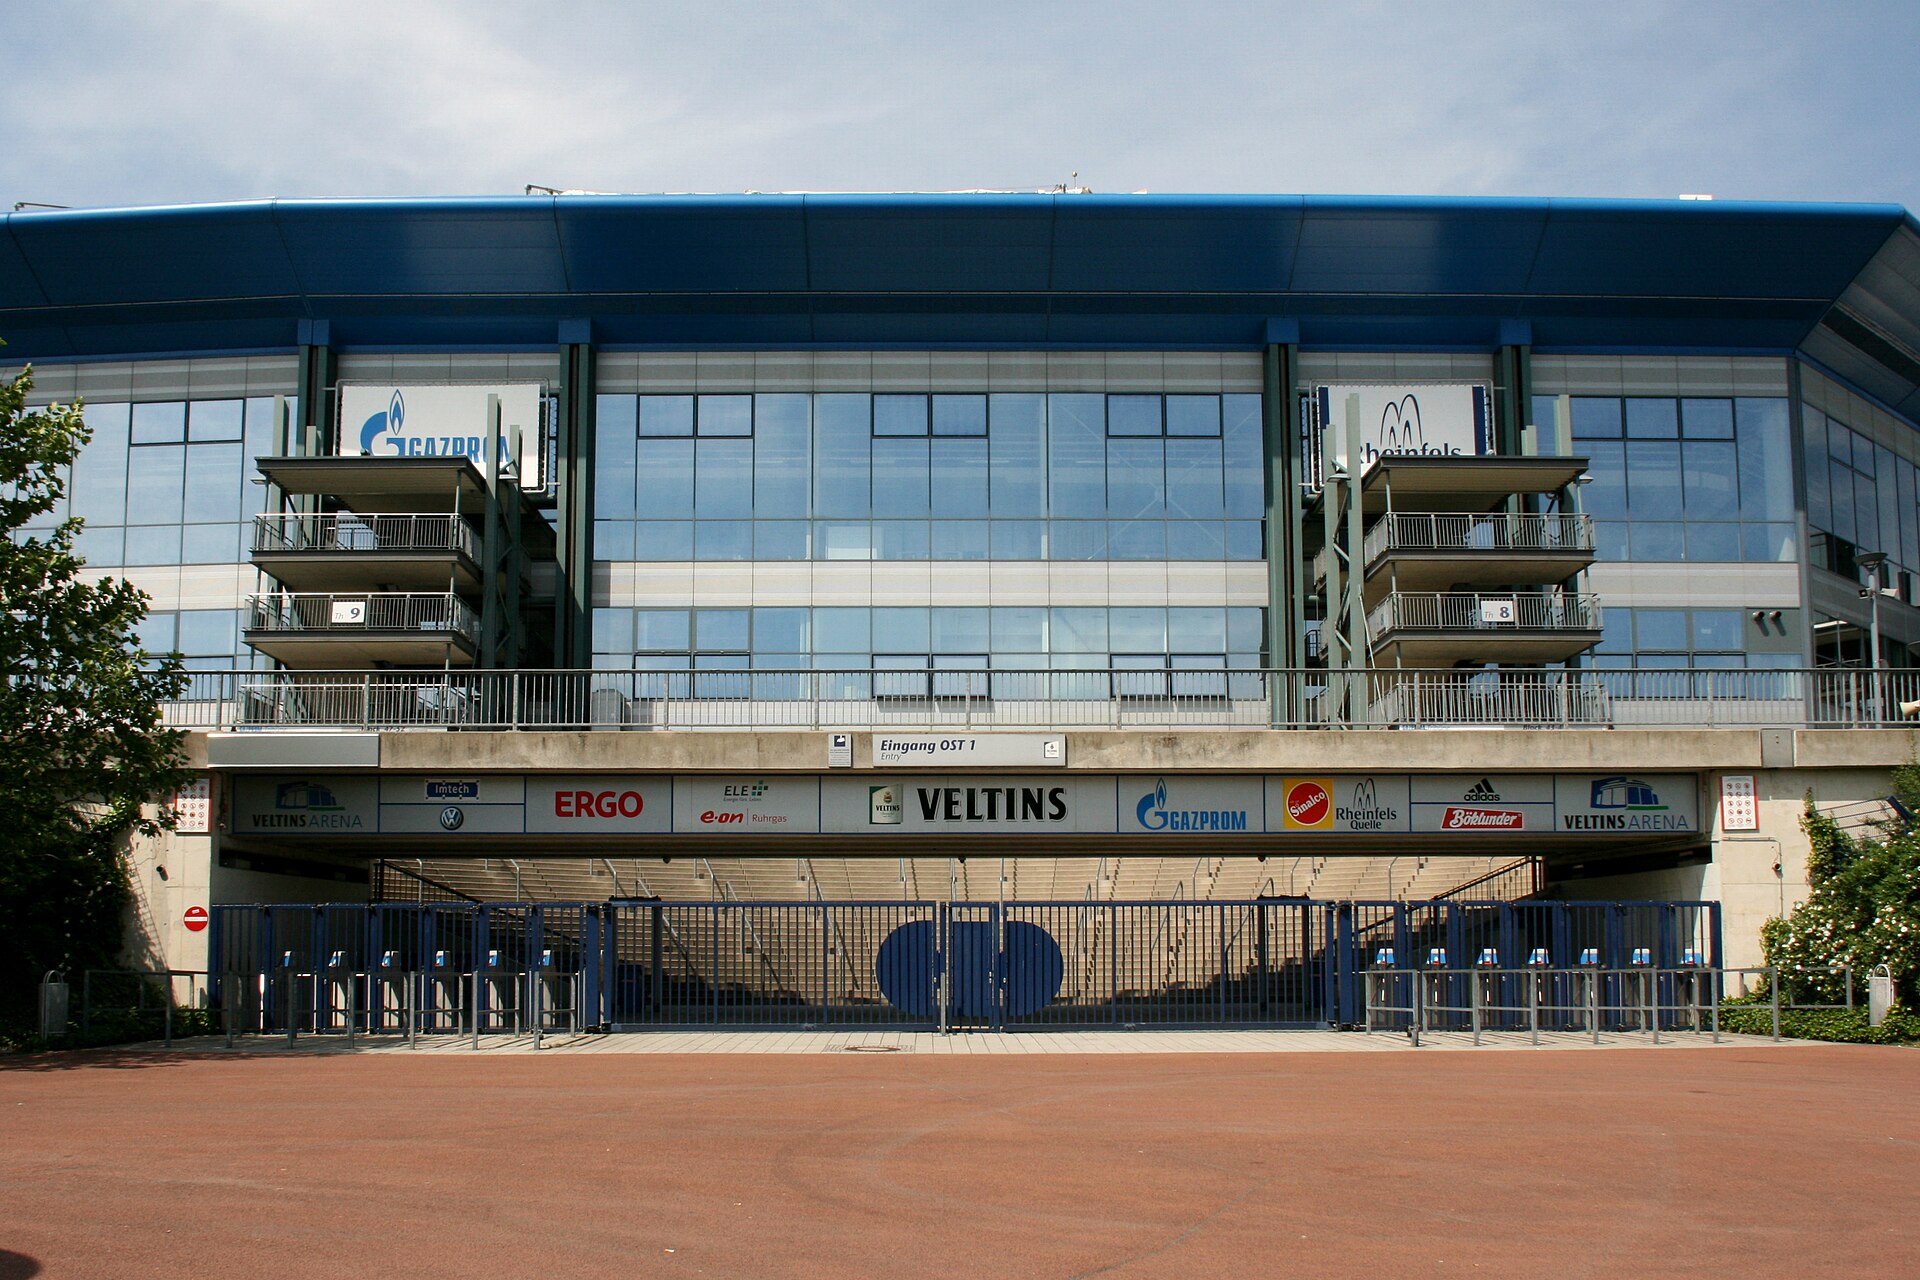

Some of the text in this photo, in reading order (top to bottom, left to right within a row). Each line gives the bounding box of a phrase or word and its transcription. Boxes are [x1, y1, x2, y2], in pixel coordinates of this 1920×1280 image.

[408, 436, 510, 463] GAZPR
[1360, 442, 1461, 464] heinfels
[350, 607, 361, 619] 9
[1499, 606, 1510, 619] 8
[880, 739, 976, 755] Eingang OST 1
[881, 752, 902, 762] Entry
[435, 784, 470, 794] Imtech
[724, 785, 749, 796] ELE
[1464, 792, 1500, 802] adidas
[555, 790, 644, 818] ERGO
[876, 804, 900, 812] VELTINS
[917, 787, 1068, 822] VELTINS
[1290, 791, 1326, 817] Sinalco
[752, 814, 787, 825] Ruhrgas
[1335, 807, 1397, 820] Rheinfels
[1449, 809, 1518, 828] Böklunder
[252, 814, 363, 828] VELTINS ARENA
[1170, 811, 1246, 830] GAZPROM
[1350, 820, 1382, 830] Quelle
[1564, 815, 1689, 829] VELTINS ARENA
